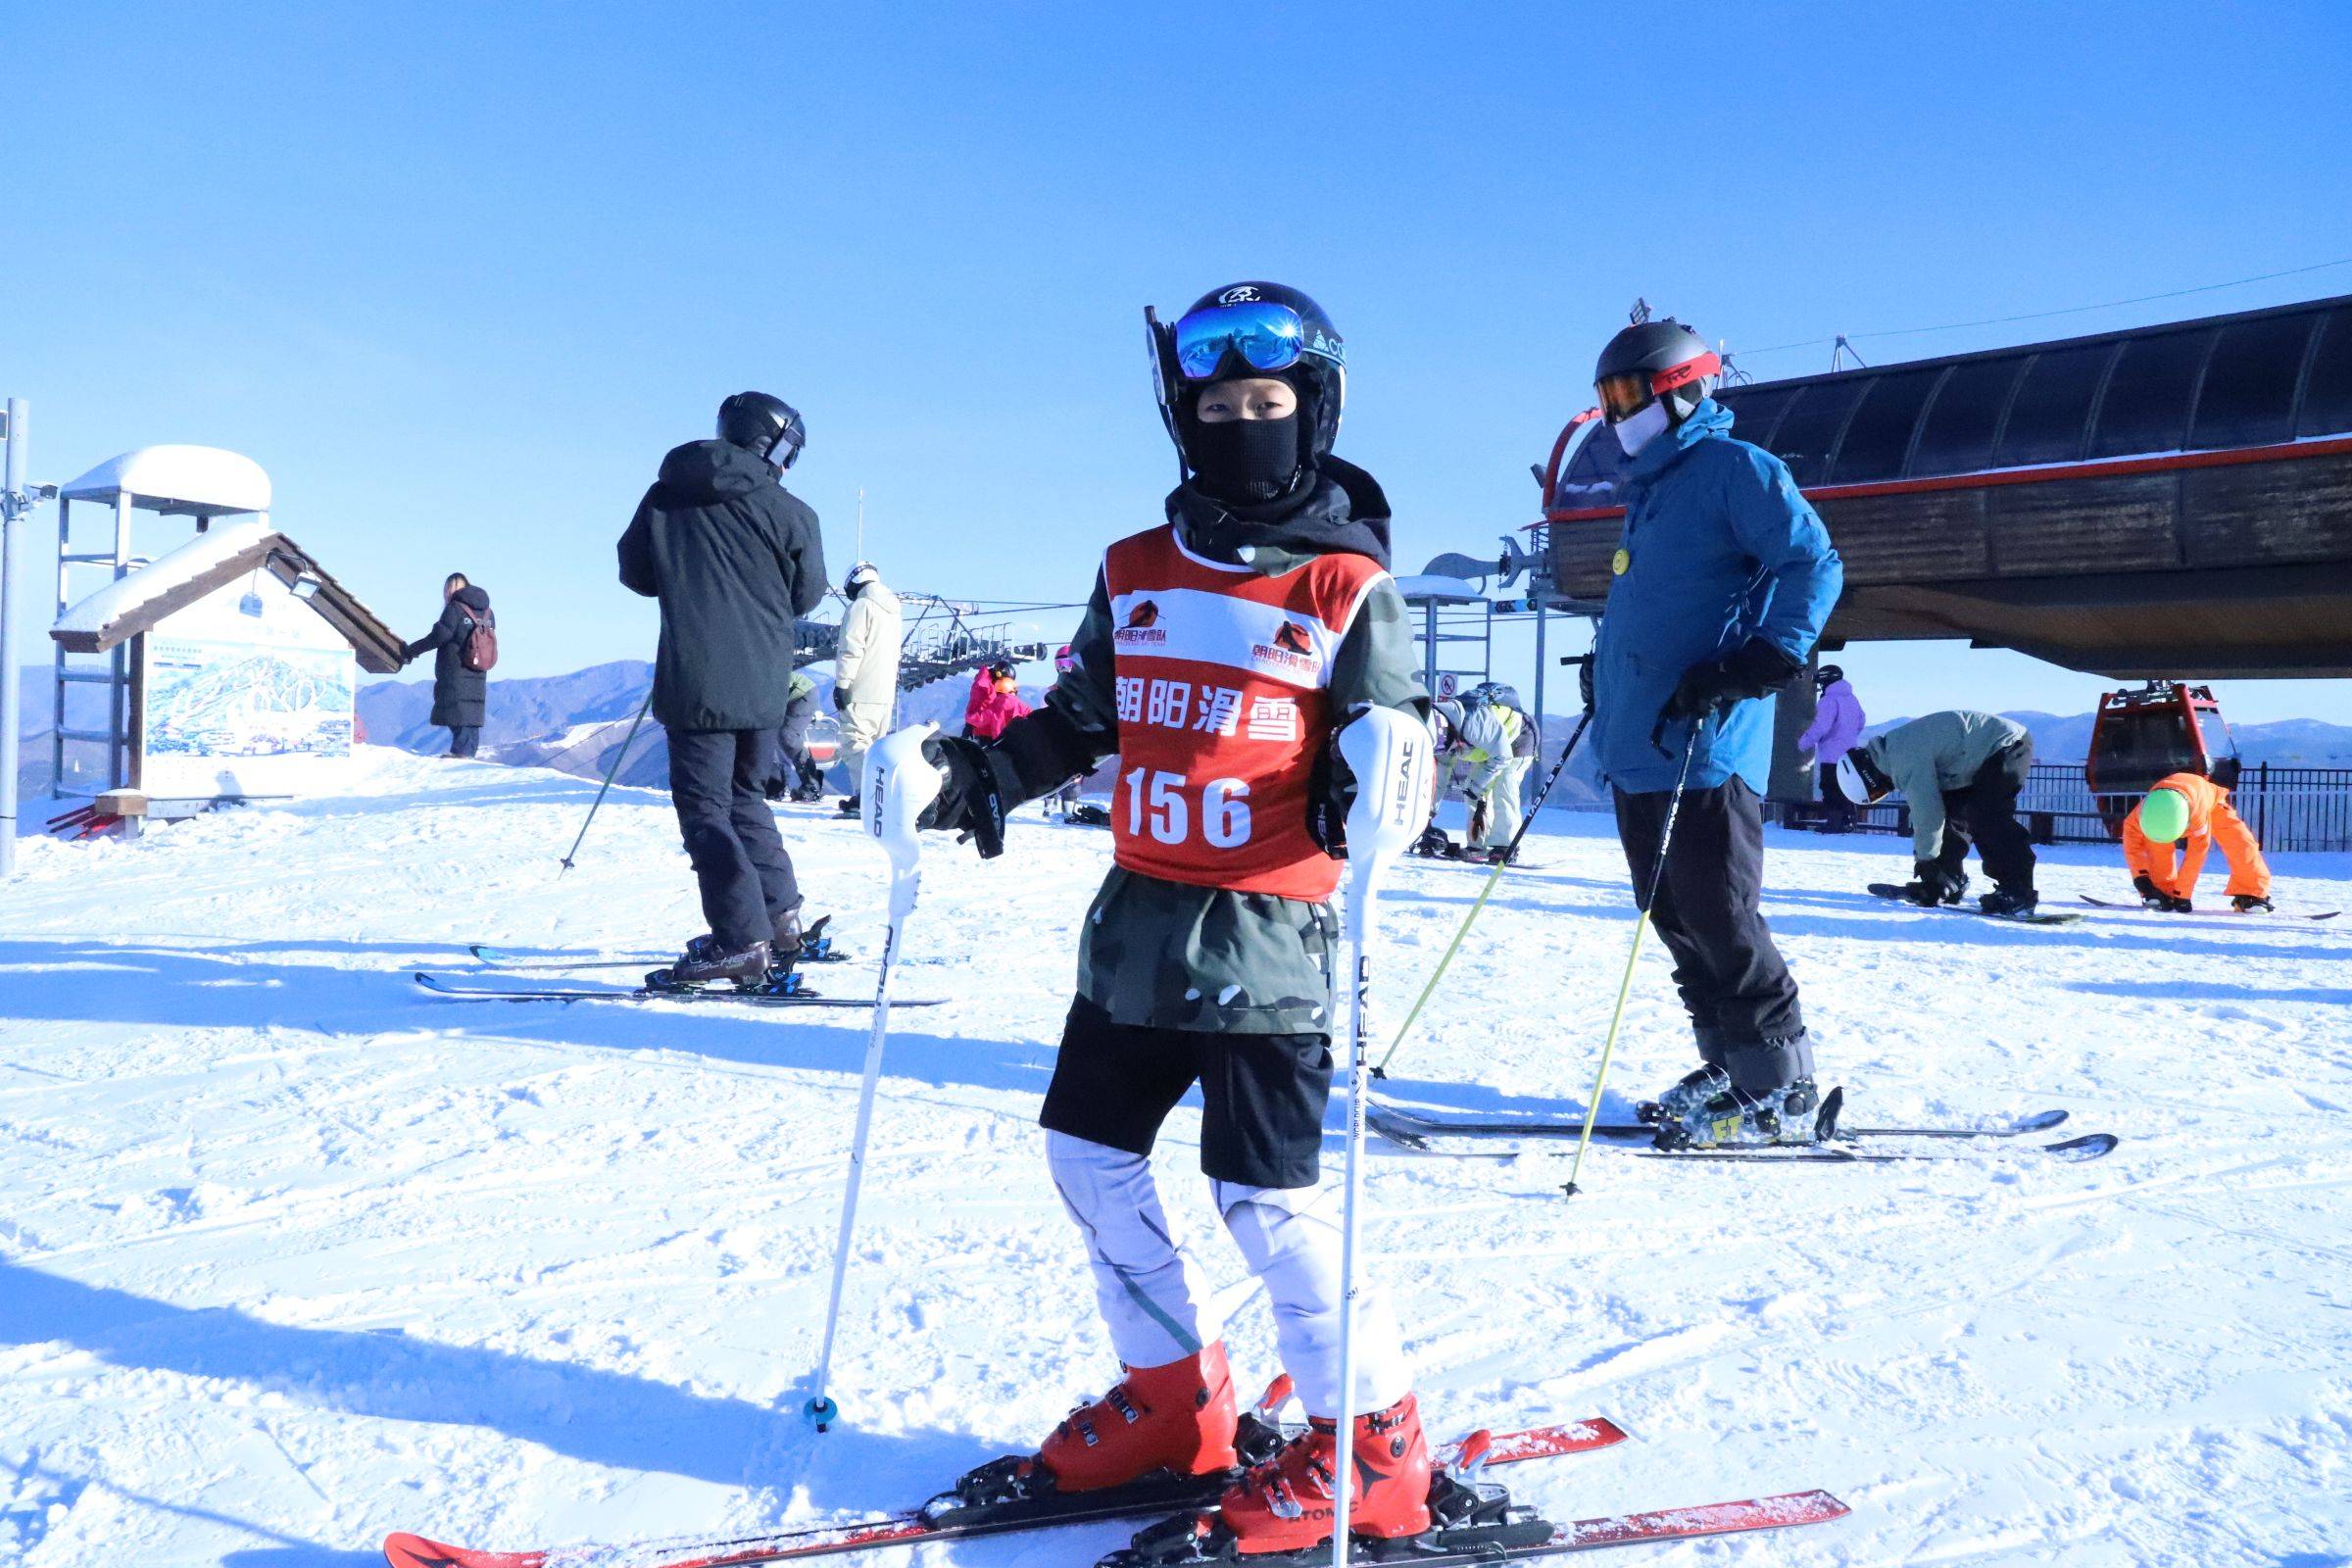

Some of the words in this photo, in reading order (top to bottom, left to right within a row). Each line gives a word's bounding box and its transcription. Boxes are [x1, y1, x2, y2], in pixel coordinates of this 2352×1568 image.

[1116, 676, 1297, 742] 朝阳滑雪
[873, 765, 886, 839] HEAD
[1126, 766, 1252, 849] 156
[1355, 955, 1370, 1068] HEAD
